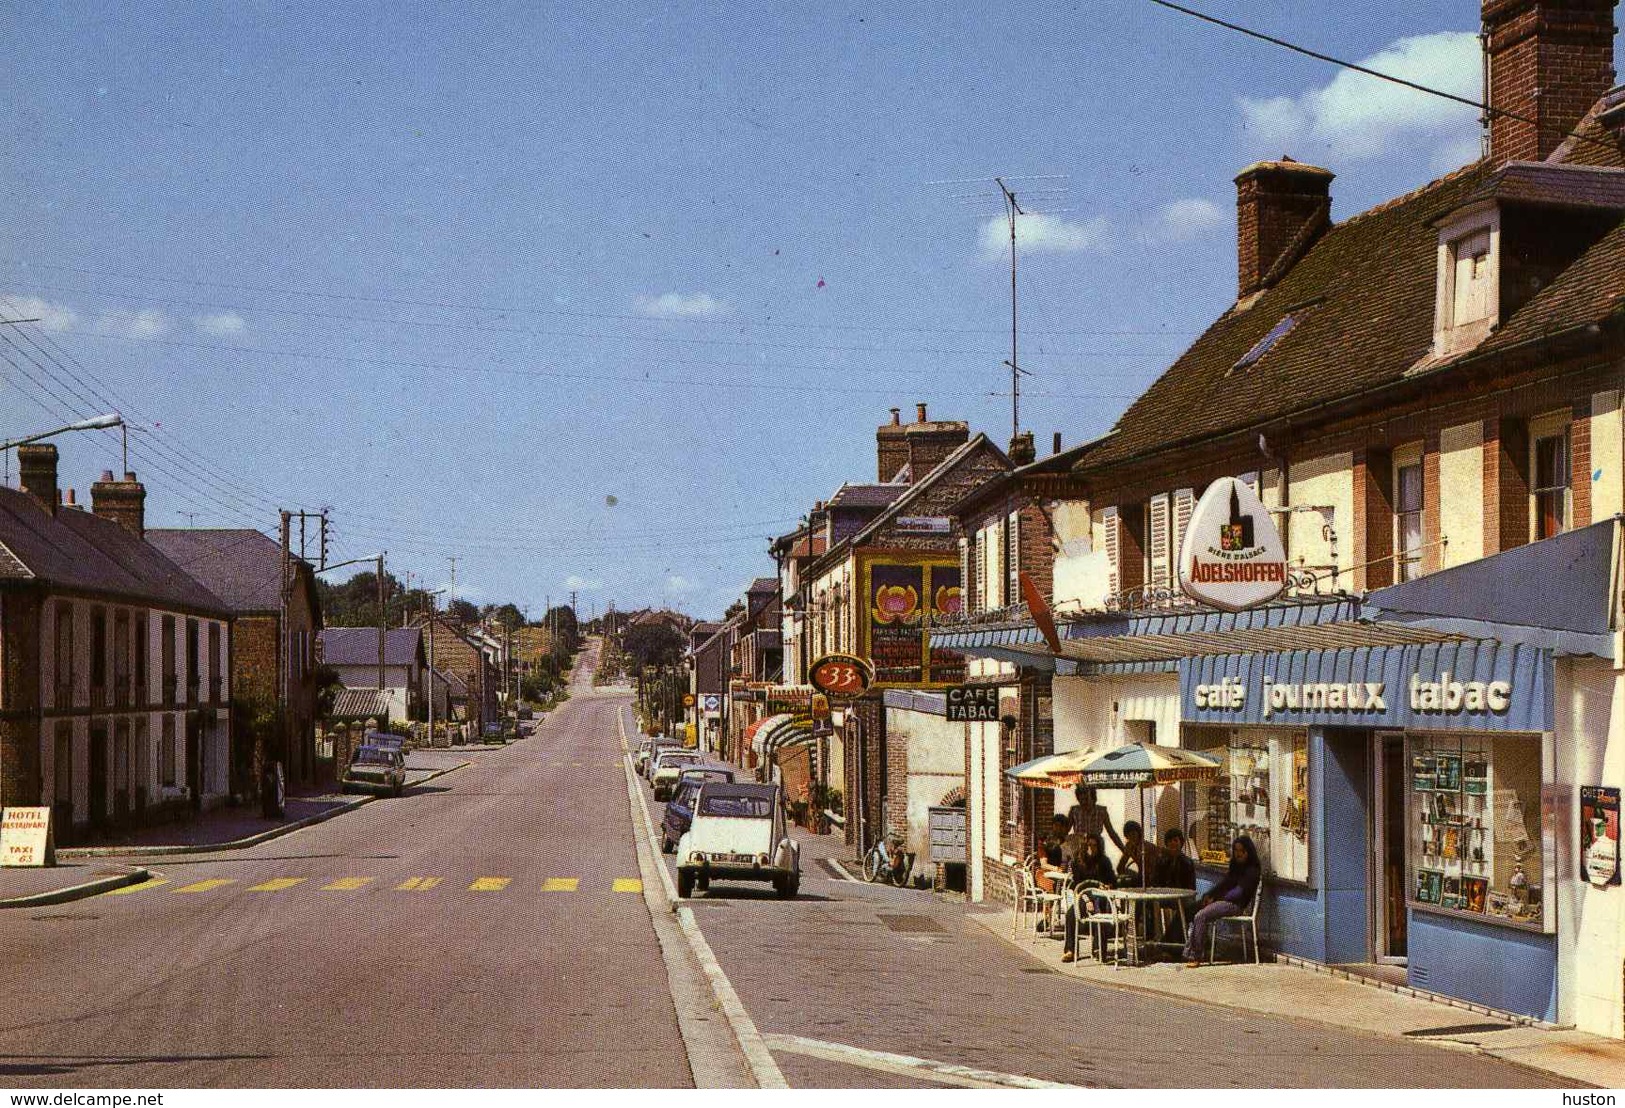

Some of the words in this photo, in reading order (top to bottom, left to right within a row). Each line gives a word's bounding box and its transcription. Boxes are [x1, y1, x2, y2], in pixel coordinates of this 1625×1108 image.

[1191, 555, 1285, 582] ADELSHOFFEN
[1195, 676, 1245, 709] café
[1263, 675, 1386, 717] journaux
[1409, 671, 1512, 712] tabac
[950, 705, 996, 719] TABAC
[8, 811, 41, 820] HOTEL
